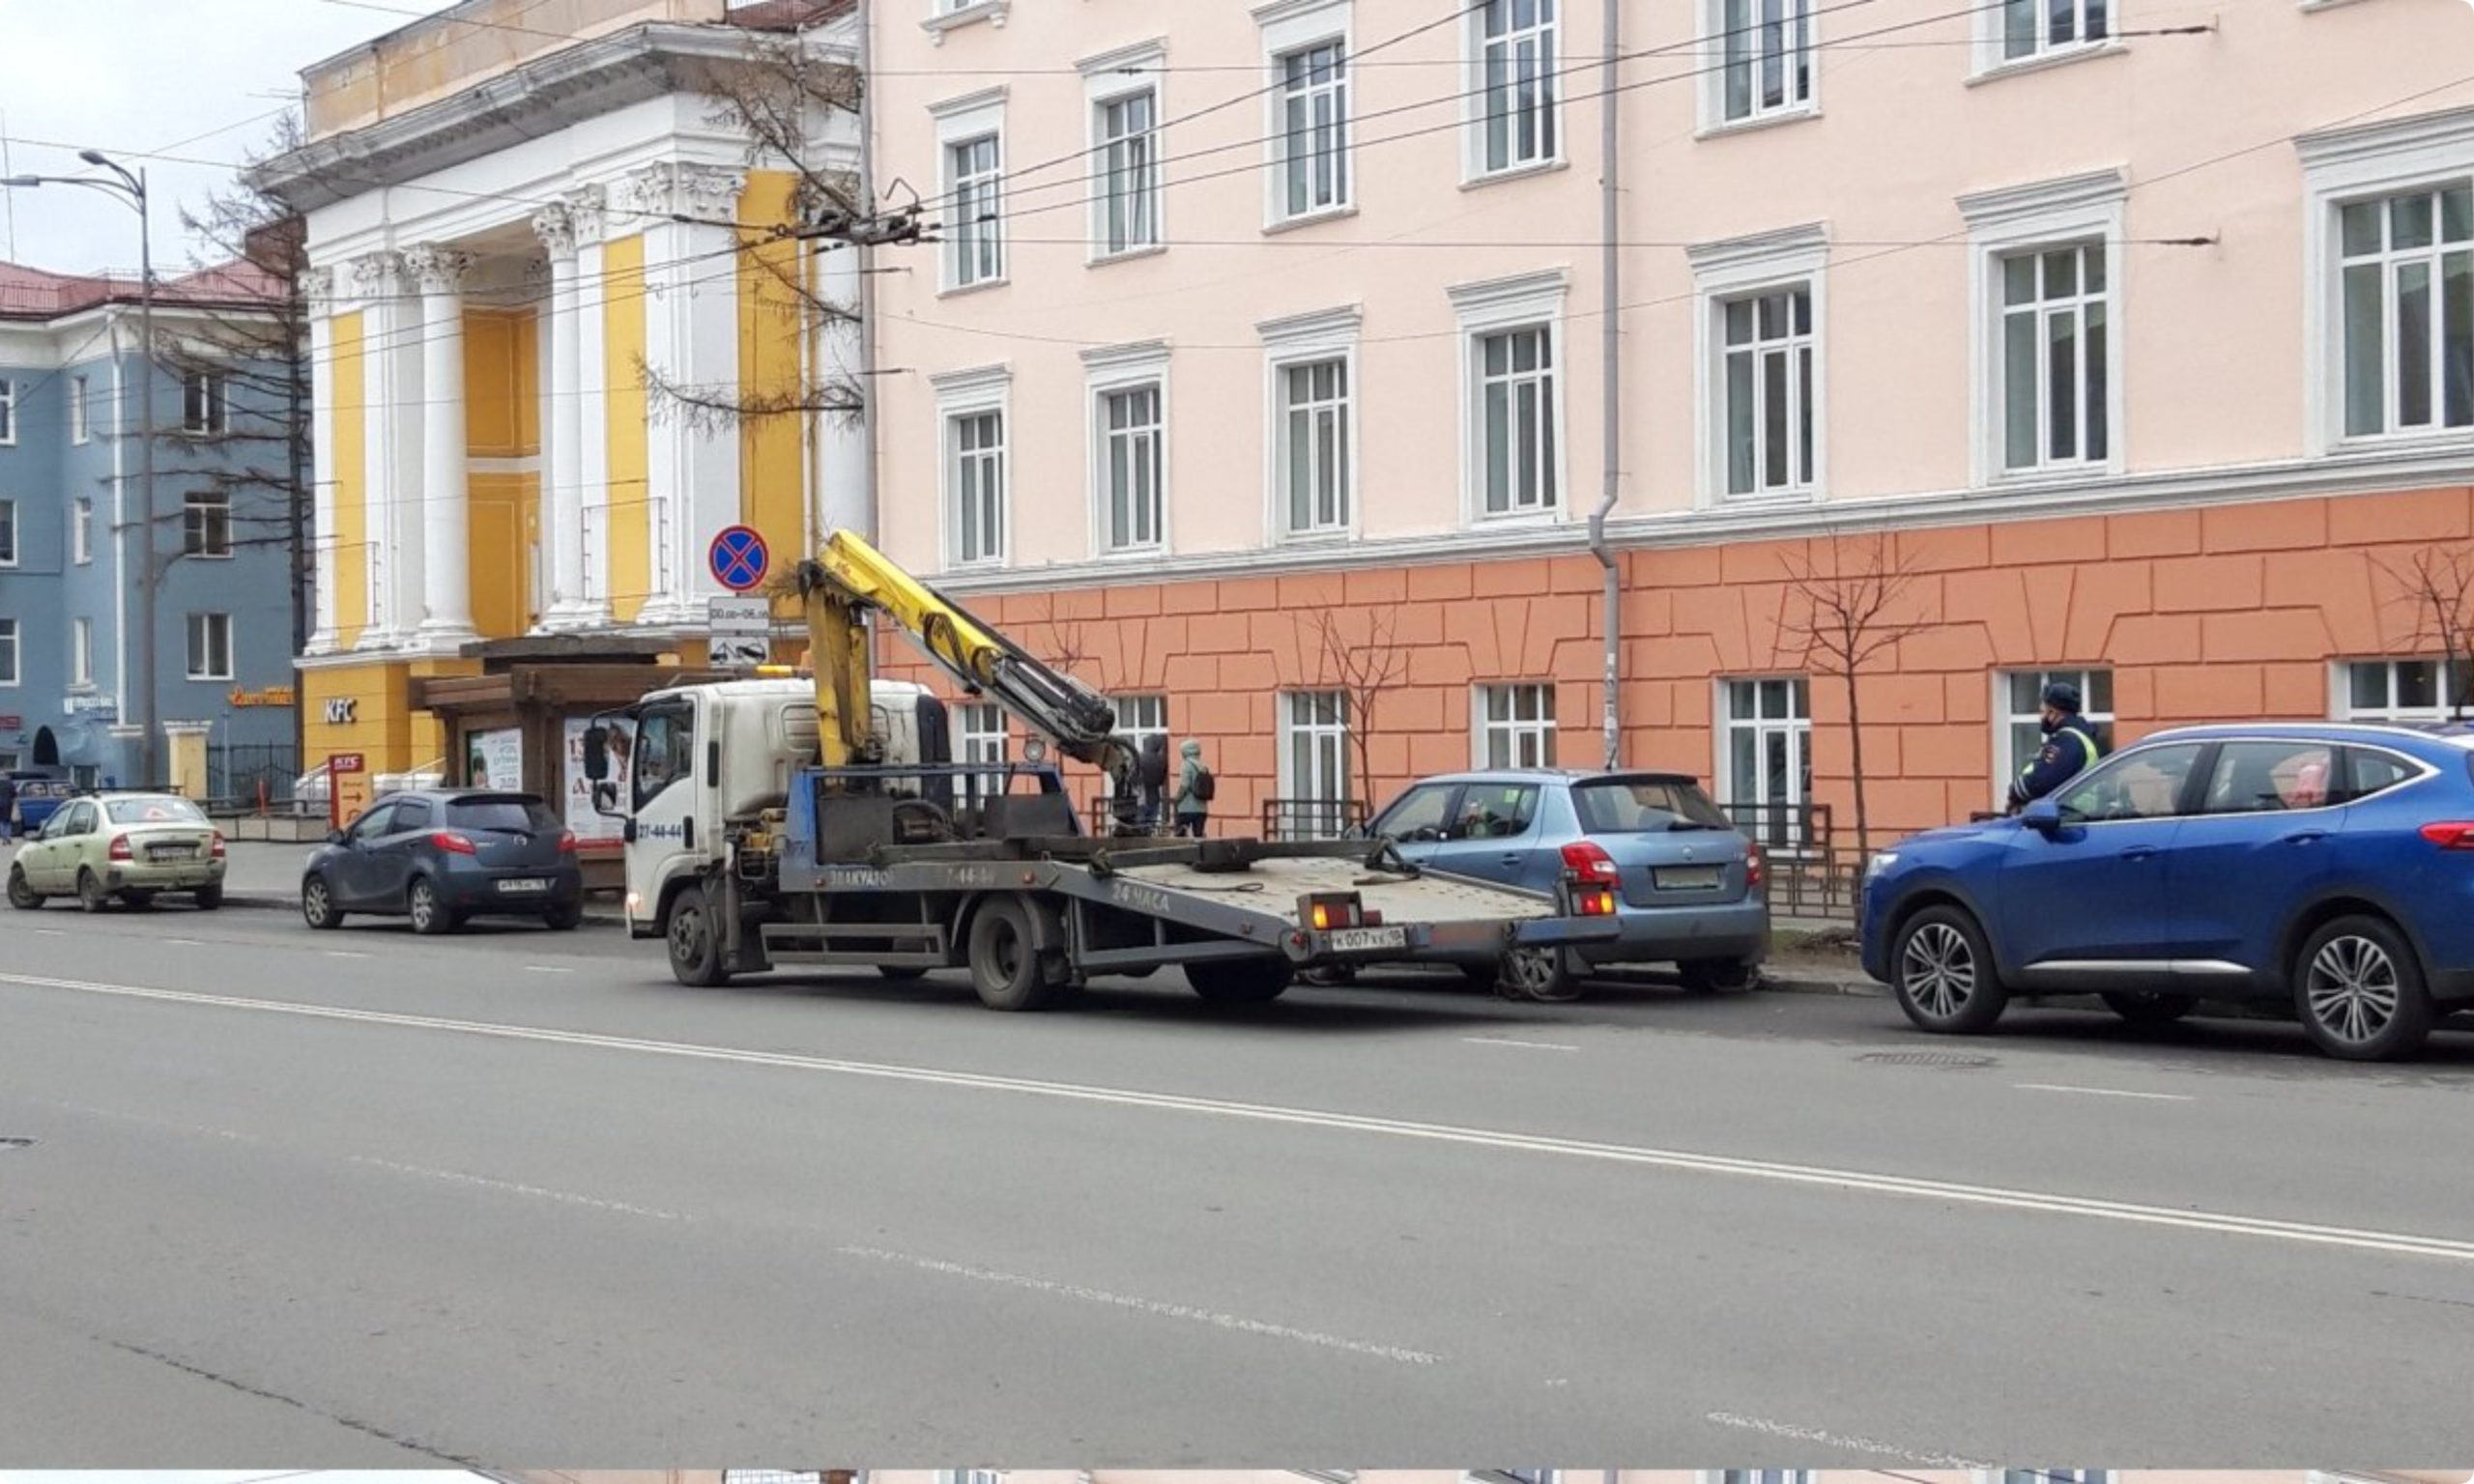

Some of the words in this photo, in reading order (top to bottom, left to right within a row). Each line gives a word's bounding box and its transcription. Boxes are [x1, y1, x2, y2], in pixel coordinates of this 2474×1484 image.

[325, 699, 358, 724] KFC
[334, 756, 359, 769] KFC
[831, 870, 893, 886] ЭВАКУАТО
